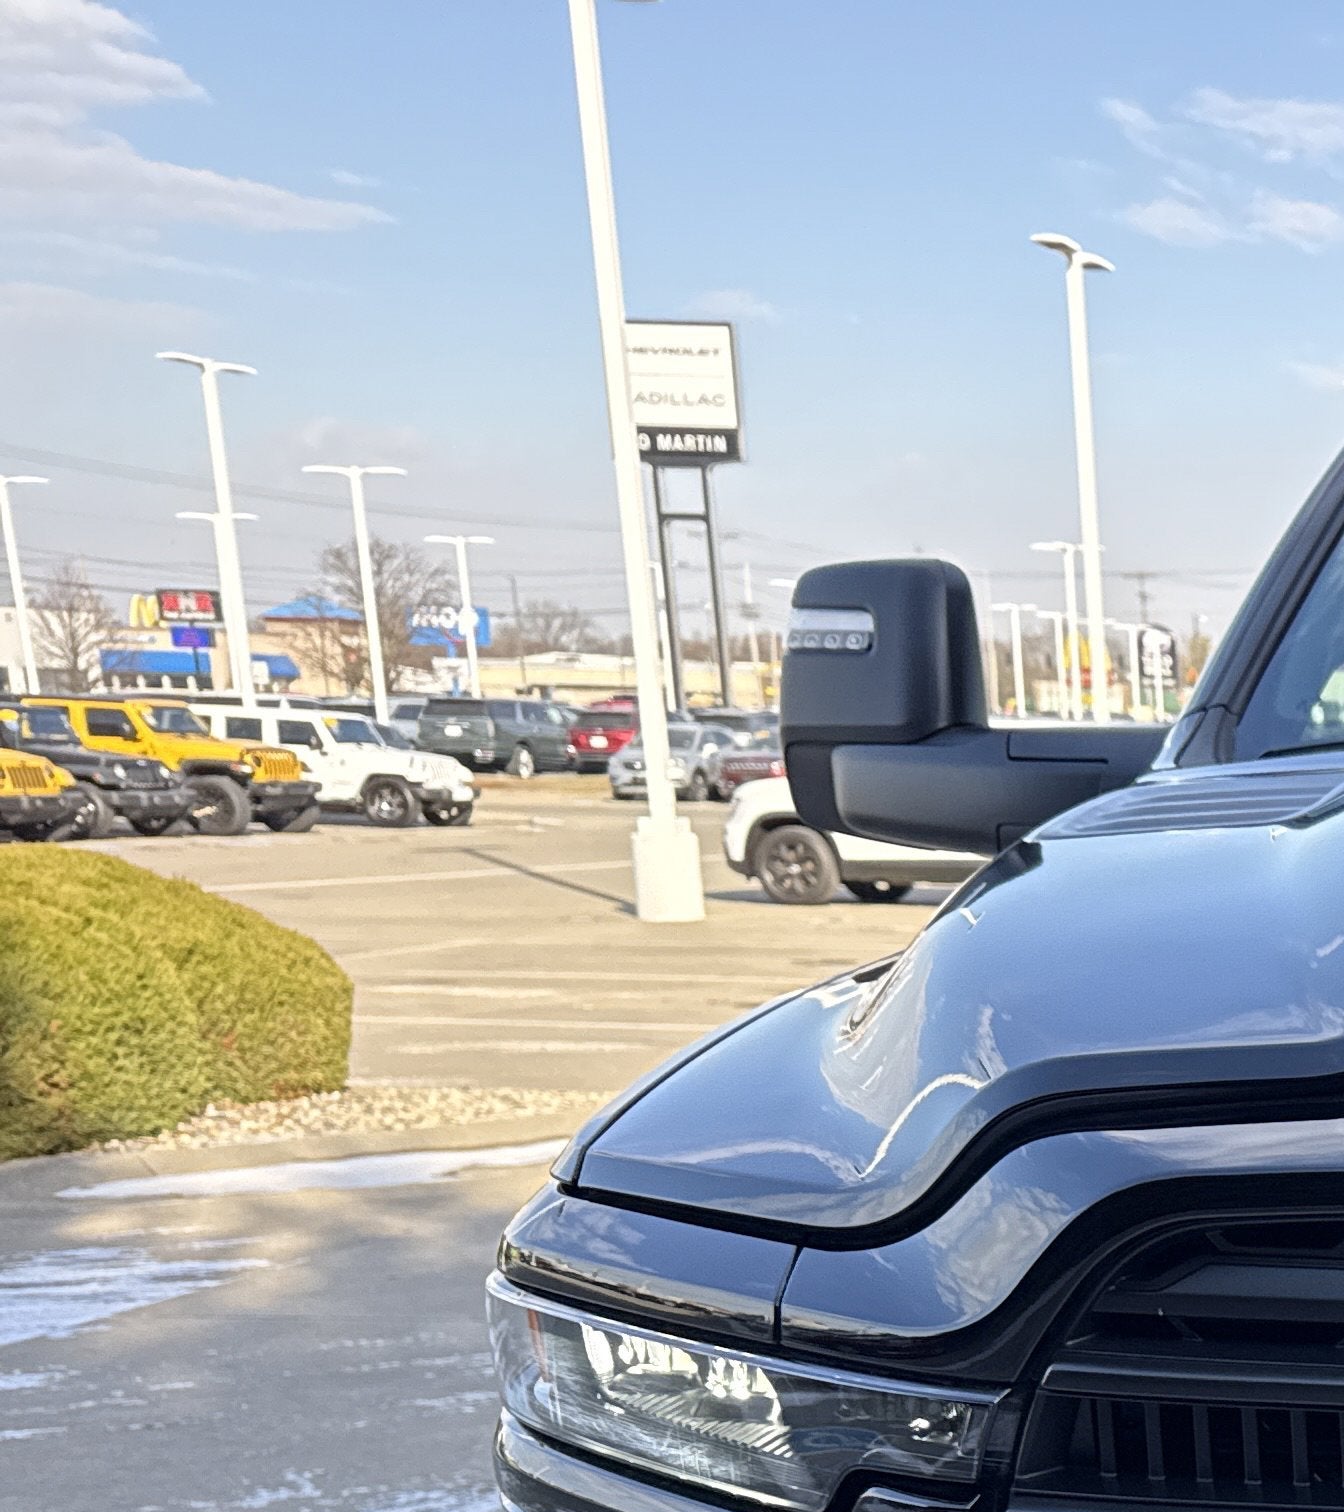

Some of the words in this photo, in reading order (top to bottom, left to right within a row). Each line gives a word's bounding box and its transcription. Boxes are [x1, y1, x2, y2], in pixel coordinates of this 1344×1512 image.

[625, 347, 719, 356] HEVROLET
[633, 391, 726, 407] ADILLAC
[656, 433, 728, 453] MARTIN
